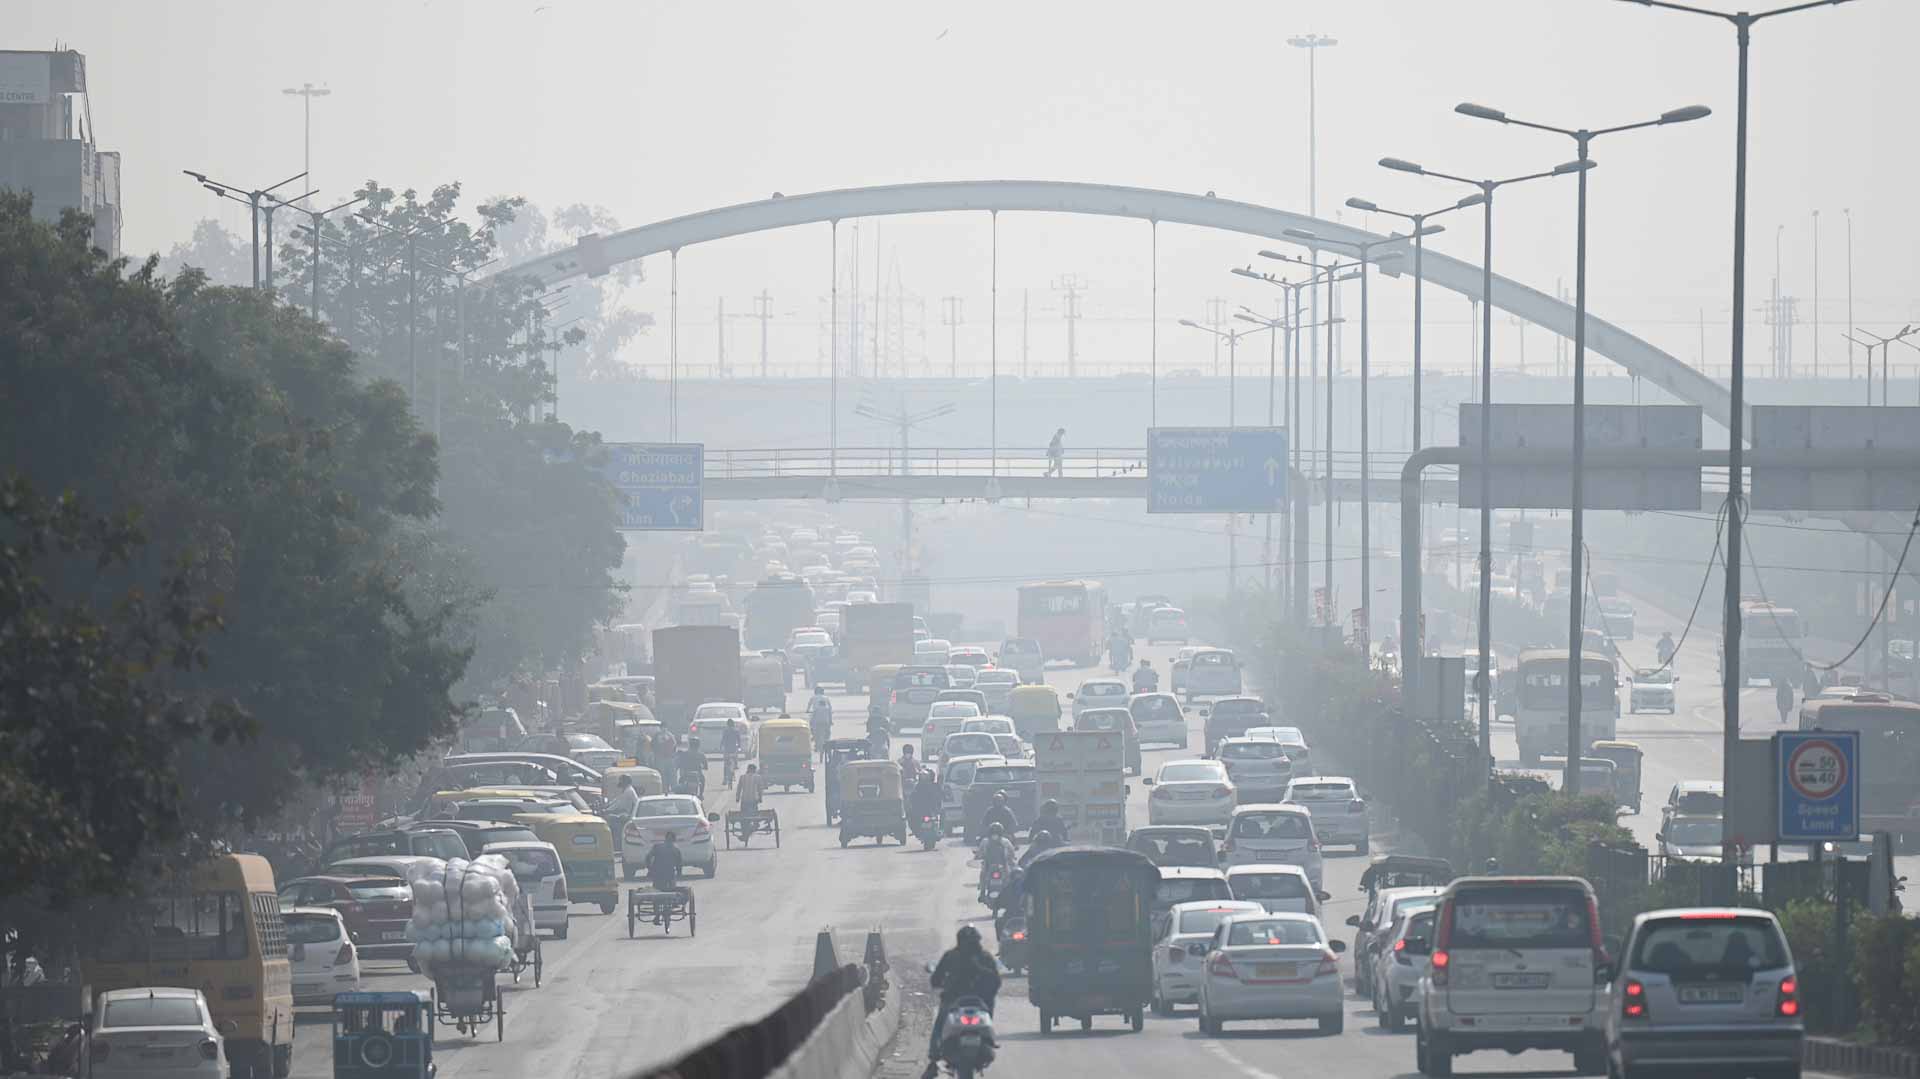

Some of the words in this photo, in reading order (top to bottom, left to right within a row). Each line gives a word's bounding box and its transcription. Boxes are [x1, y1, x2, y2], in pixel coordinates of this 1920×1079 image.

[618, 471, 694, 482] Ghaziabad
[1158, 493, 1203, 505] Noida
[1819, 755, 1836, 769] 50
[1818, 772, 1836, 784] 40
[1798, 802, 1839, 816] Speed
[1802, 817, 1835, 831] Limit
